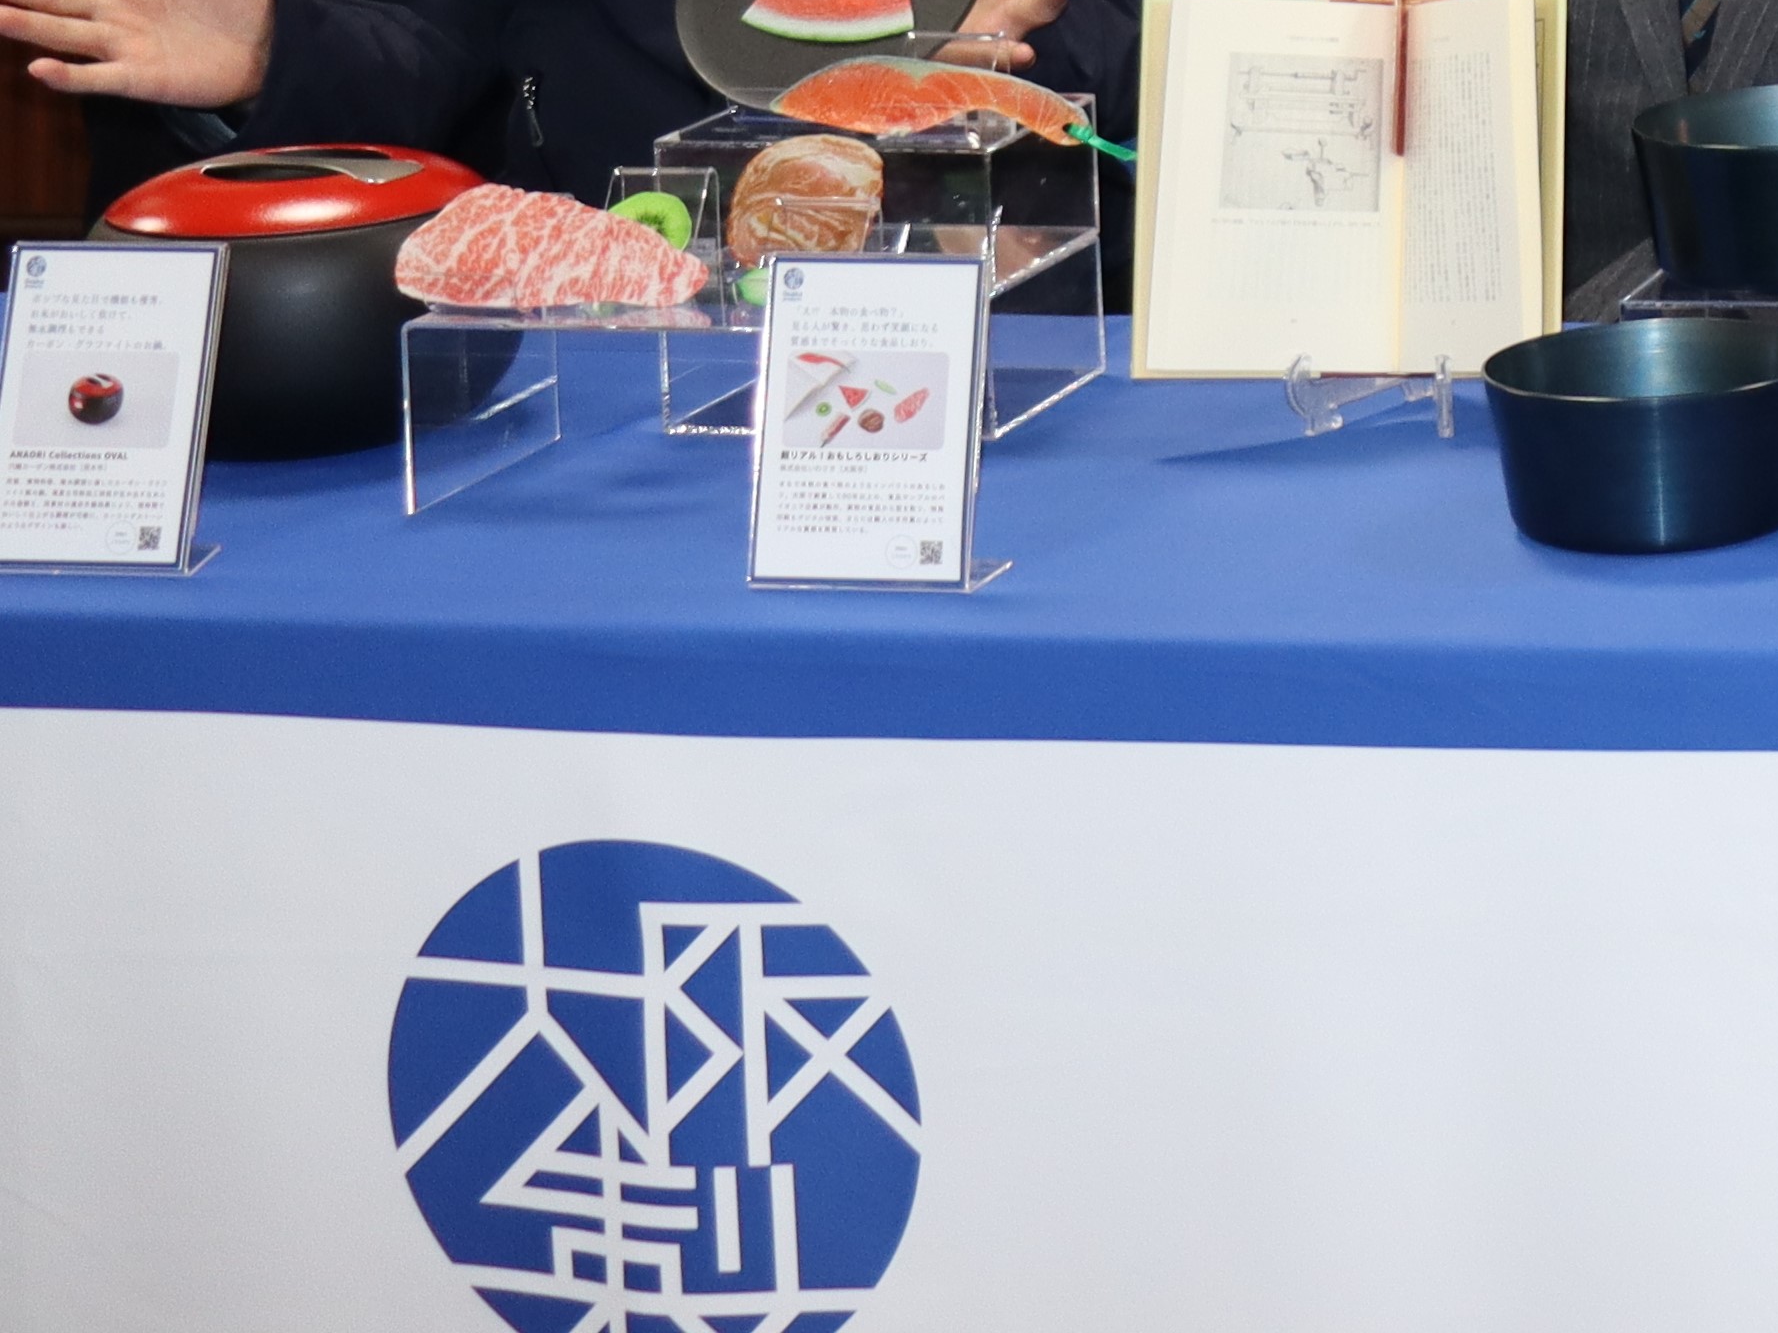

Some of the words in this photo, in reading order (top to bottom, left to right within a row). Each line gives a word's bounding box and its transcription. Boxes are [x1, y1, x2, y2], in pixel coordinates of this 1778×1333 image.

[9, 449, 47, 461] ANAORI
[49, 449, 101, 461] Collections
[104, 450, 129, 461] OVAL
